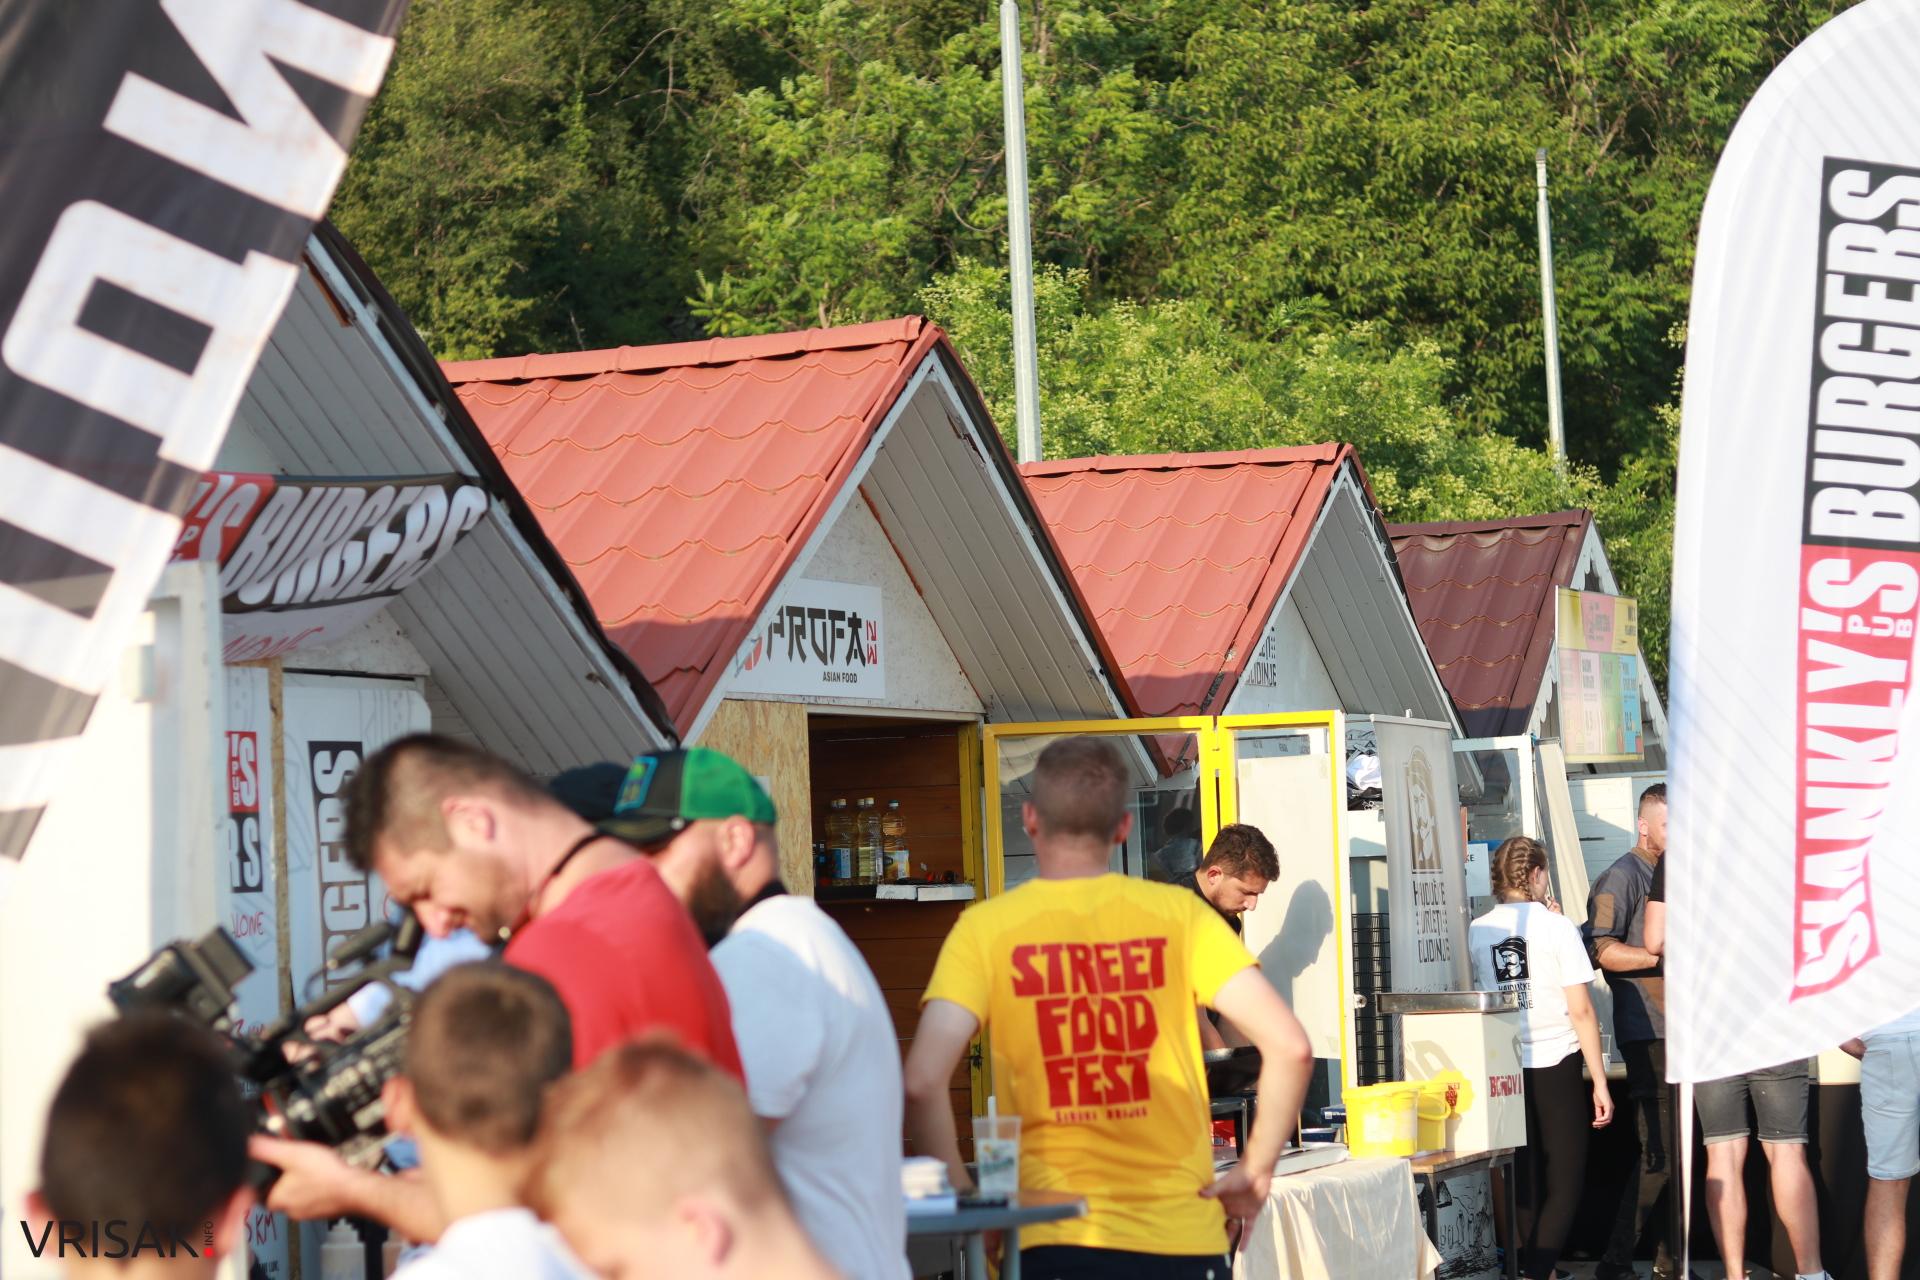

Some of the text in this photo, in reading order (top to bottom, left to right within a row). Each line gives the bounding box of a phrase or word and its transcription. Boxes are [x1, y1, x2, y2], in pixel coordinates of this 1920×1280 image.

[1809, 168, 1920, 544] BURGERS
[1846, 611, 1914, 638] PUB
[822, 671, 858, 684] ASIAN FOOD
[1011, 938, 1167, 996] STREET
[1036, 994, 1158, 1056] FOOD
[1045, 1053, 1151, 1107] FEST
